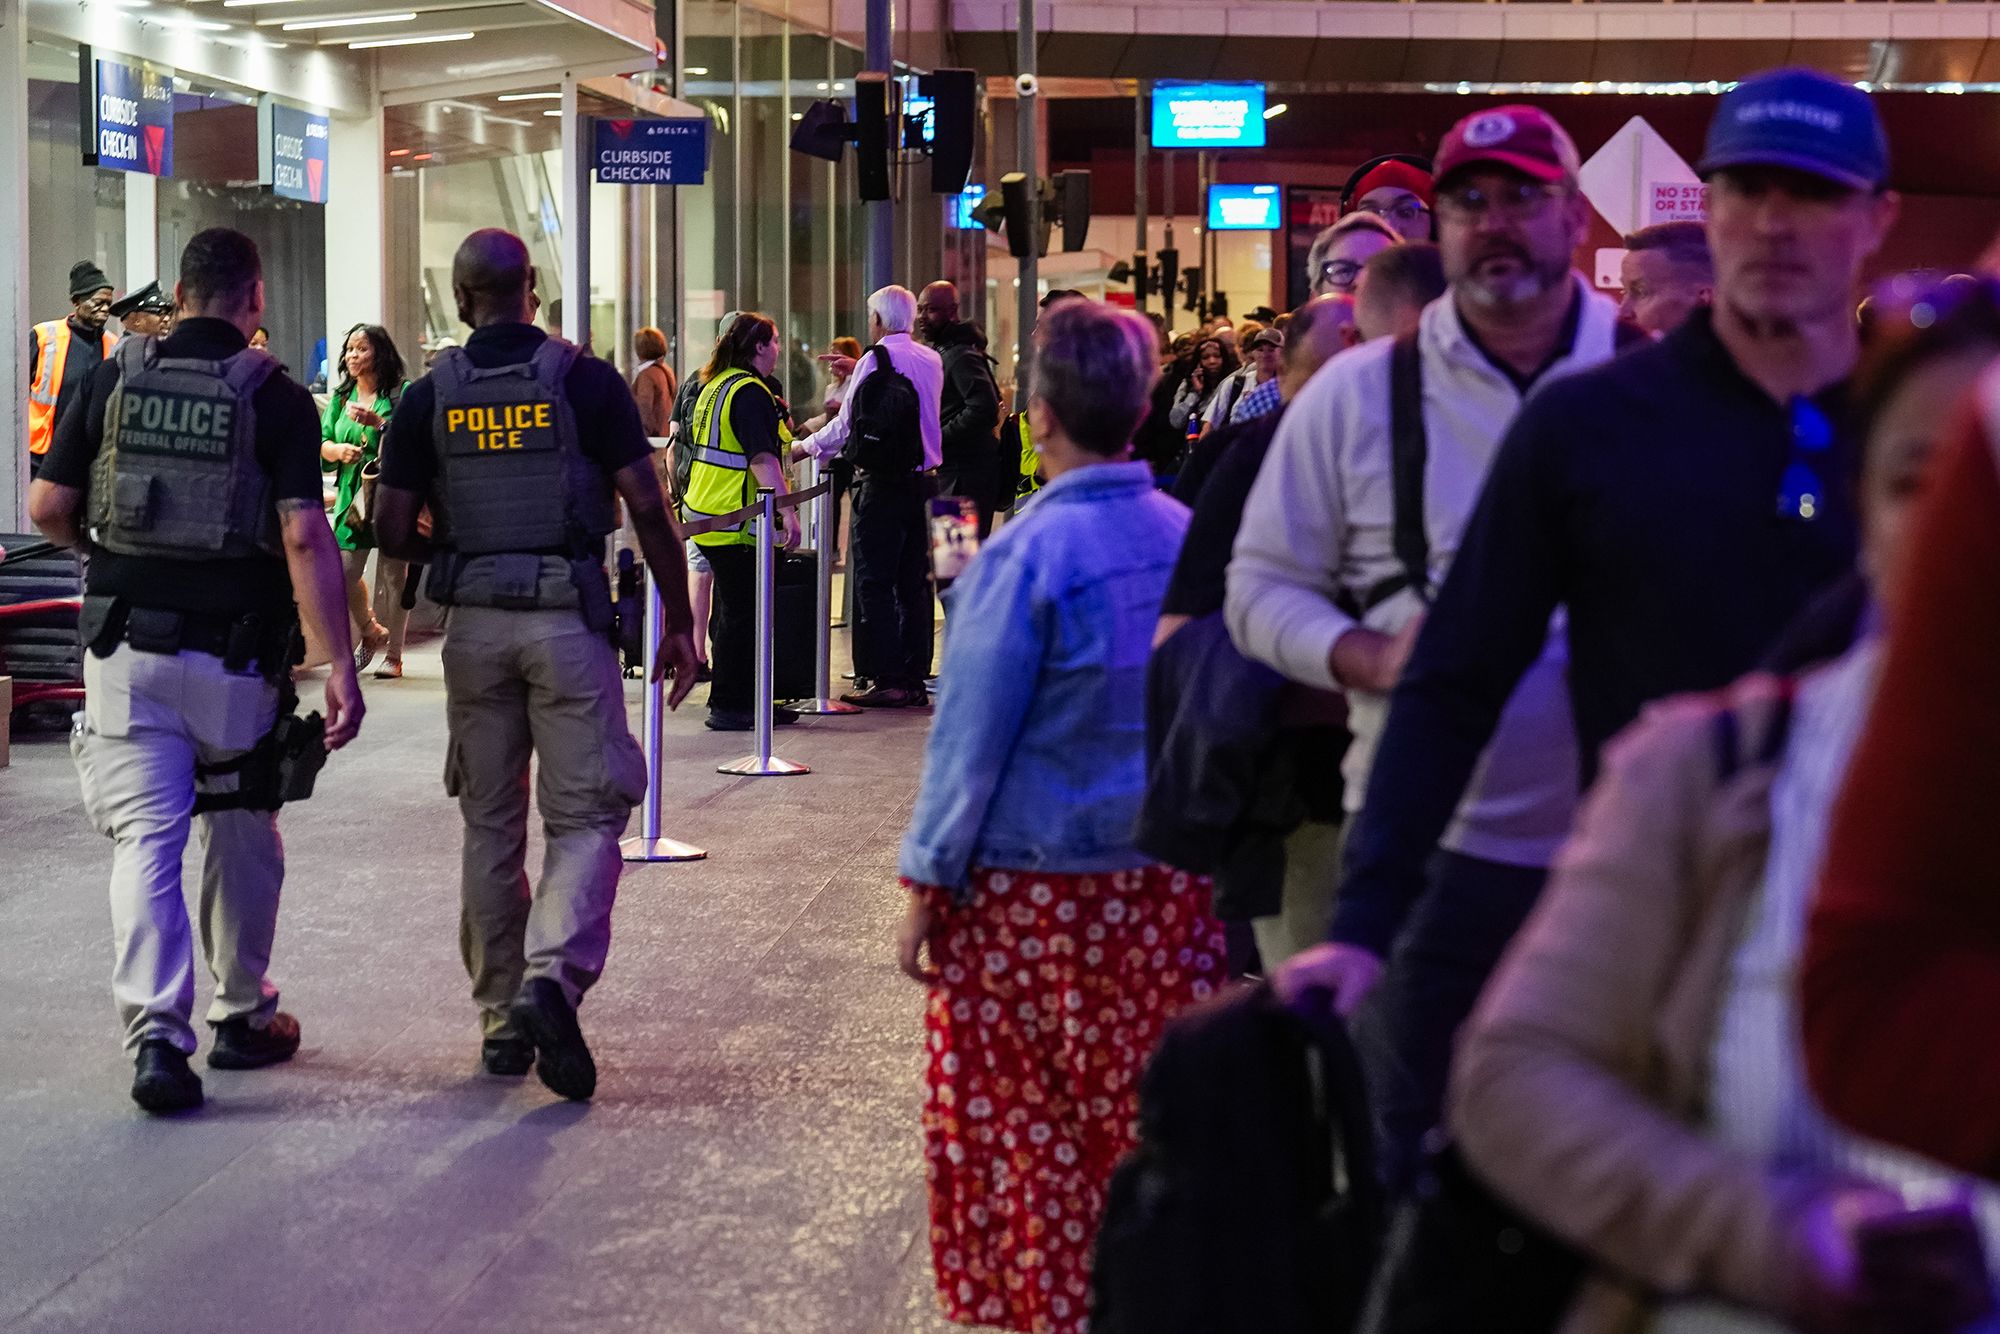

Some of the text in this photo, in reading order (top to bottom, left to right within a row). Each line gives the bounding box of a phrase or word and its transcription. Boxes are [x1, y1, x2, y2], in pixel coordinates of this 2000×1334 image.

[100, 94, 138, 127] CURBSIDE
[656, 127, 689, 135] DELTA
[100, 129, 138, 160] CHECK-IN
[600, 150, 673, 164] CURBSIDE
[600, 167, 672, 181] CHECK-IN
[1656, 187, 1678, 198] NO
[1655, 200, 1676, 211] OR
[121, 393, 232, 437] POLICE
[447, 403, 552, 432] POLICE
[119, 429, 226, 455] FEDERAL OFFICER
[478, 430, 523, 450] ICE
